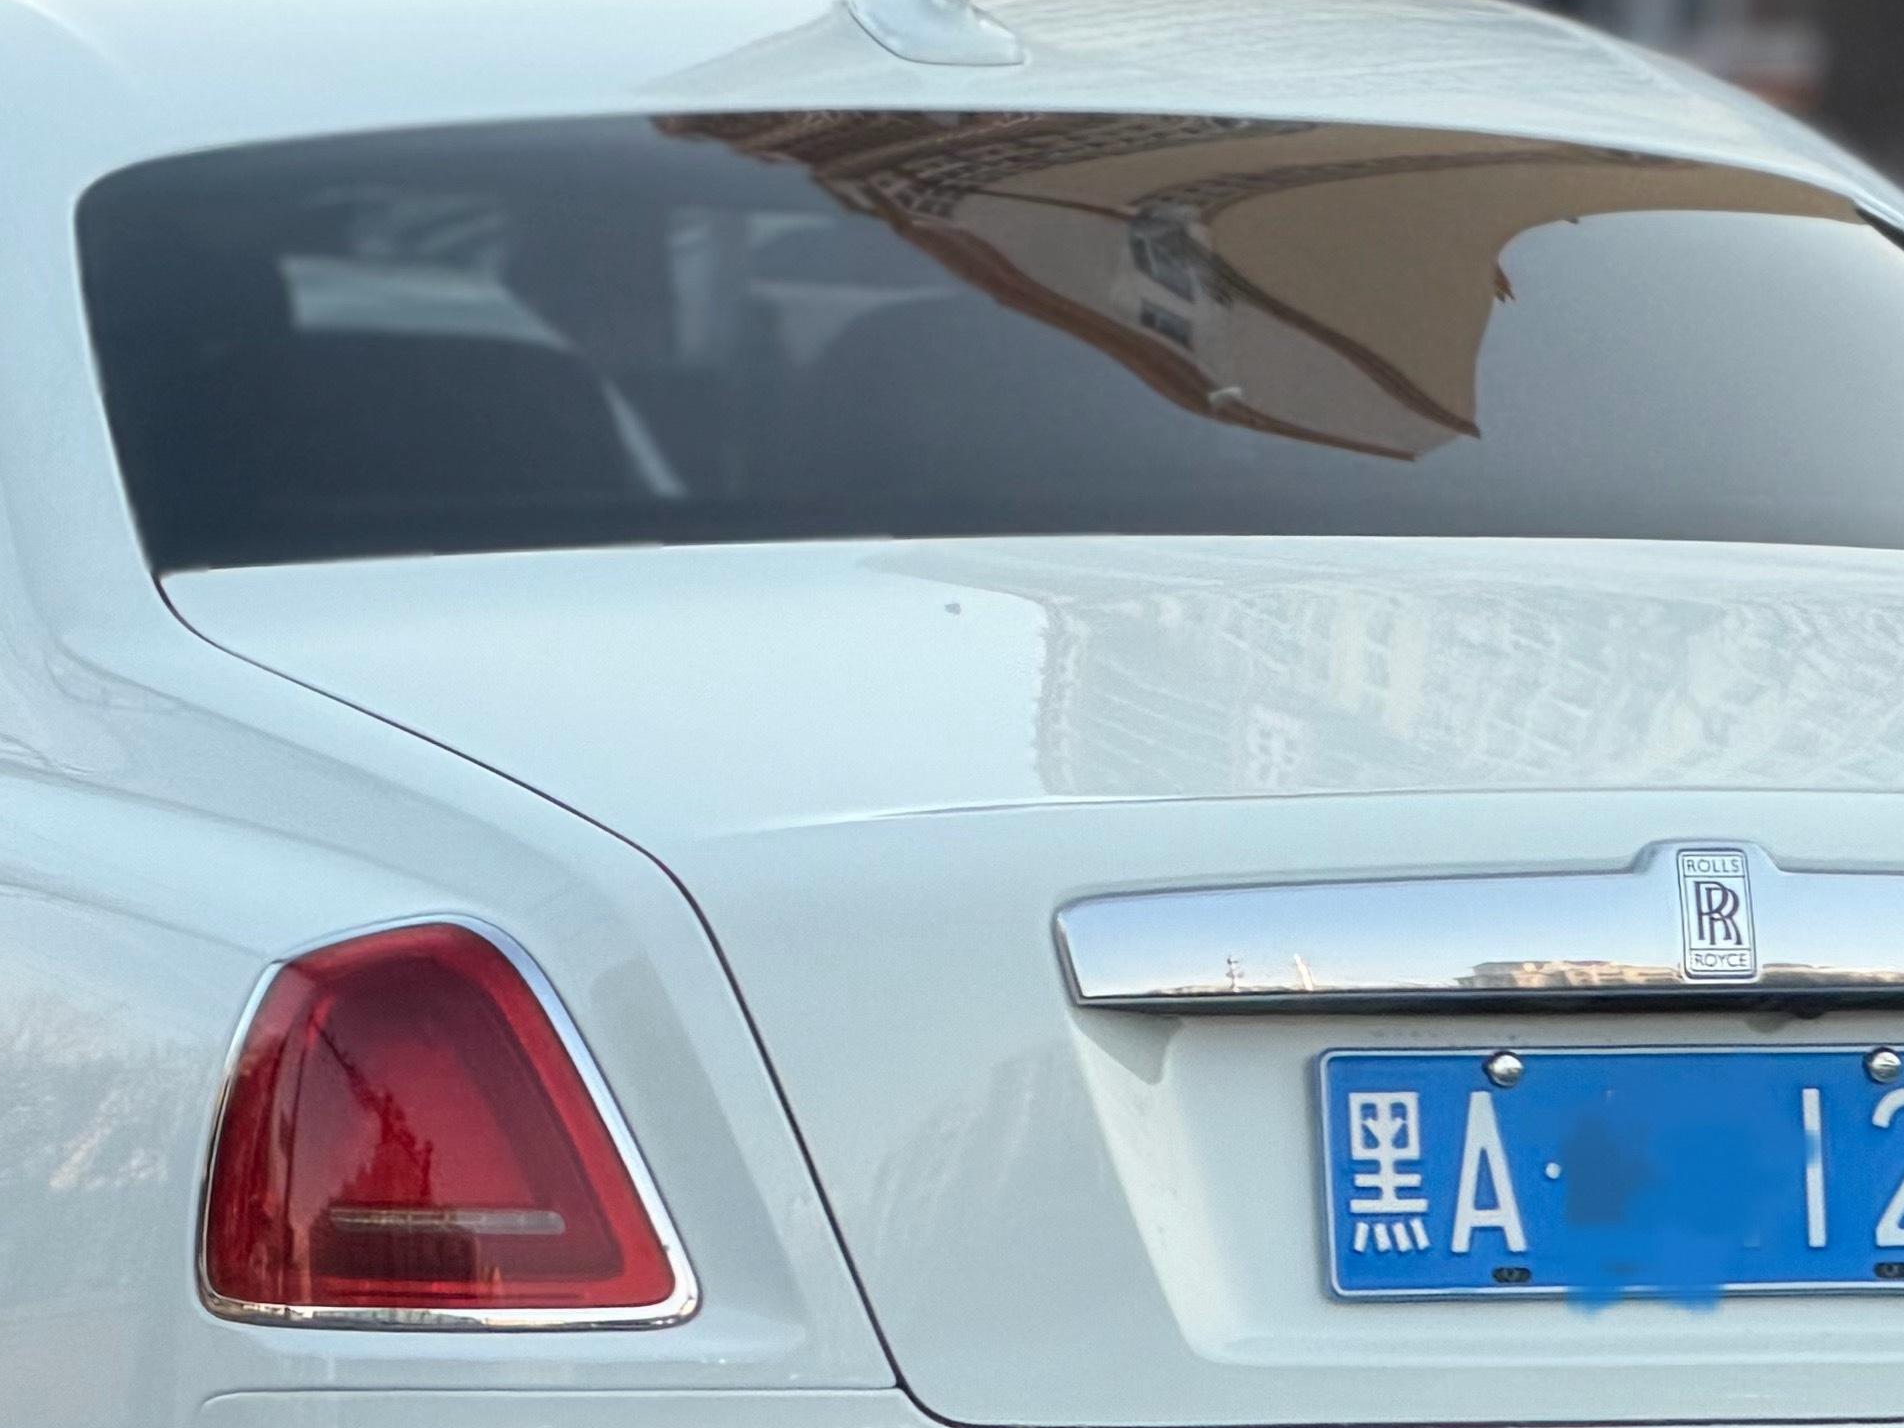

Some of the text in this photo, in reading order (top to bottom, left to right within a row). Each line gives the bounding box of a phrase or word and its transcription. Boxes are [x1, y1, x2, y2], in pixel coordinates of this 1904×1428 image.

[1686, 859, 1740, 874] ROLLS
[1694, 881, 1743, 946] RR
[1693, 953, 1748, 968] ROYCE
